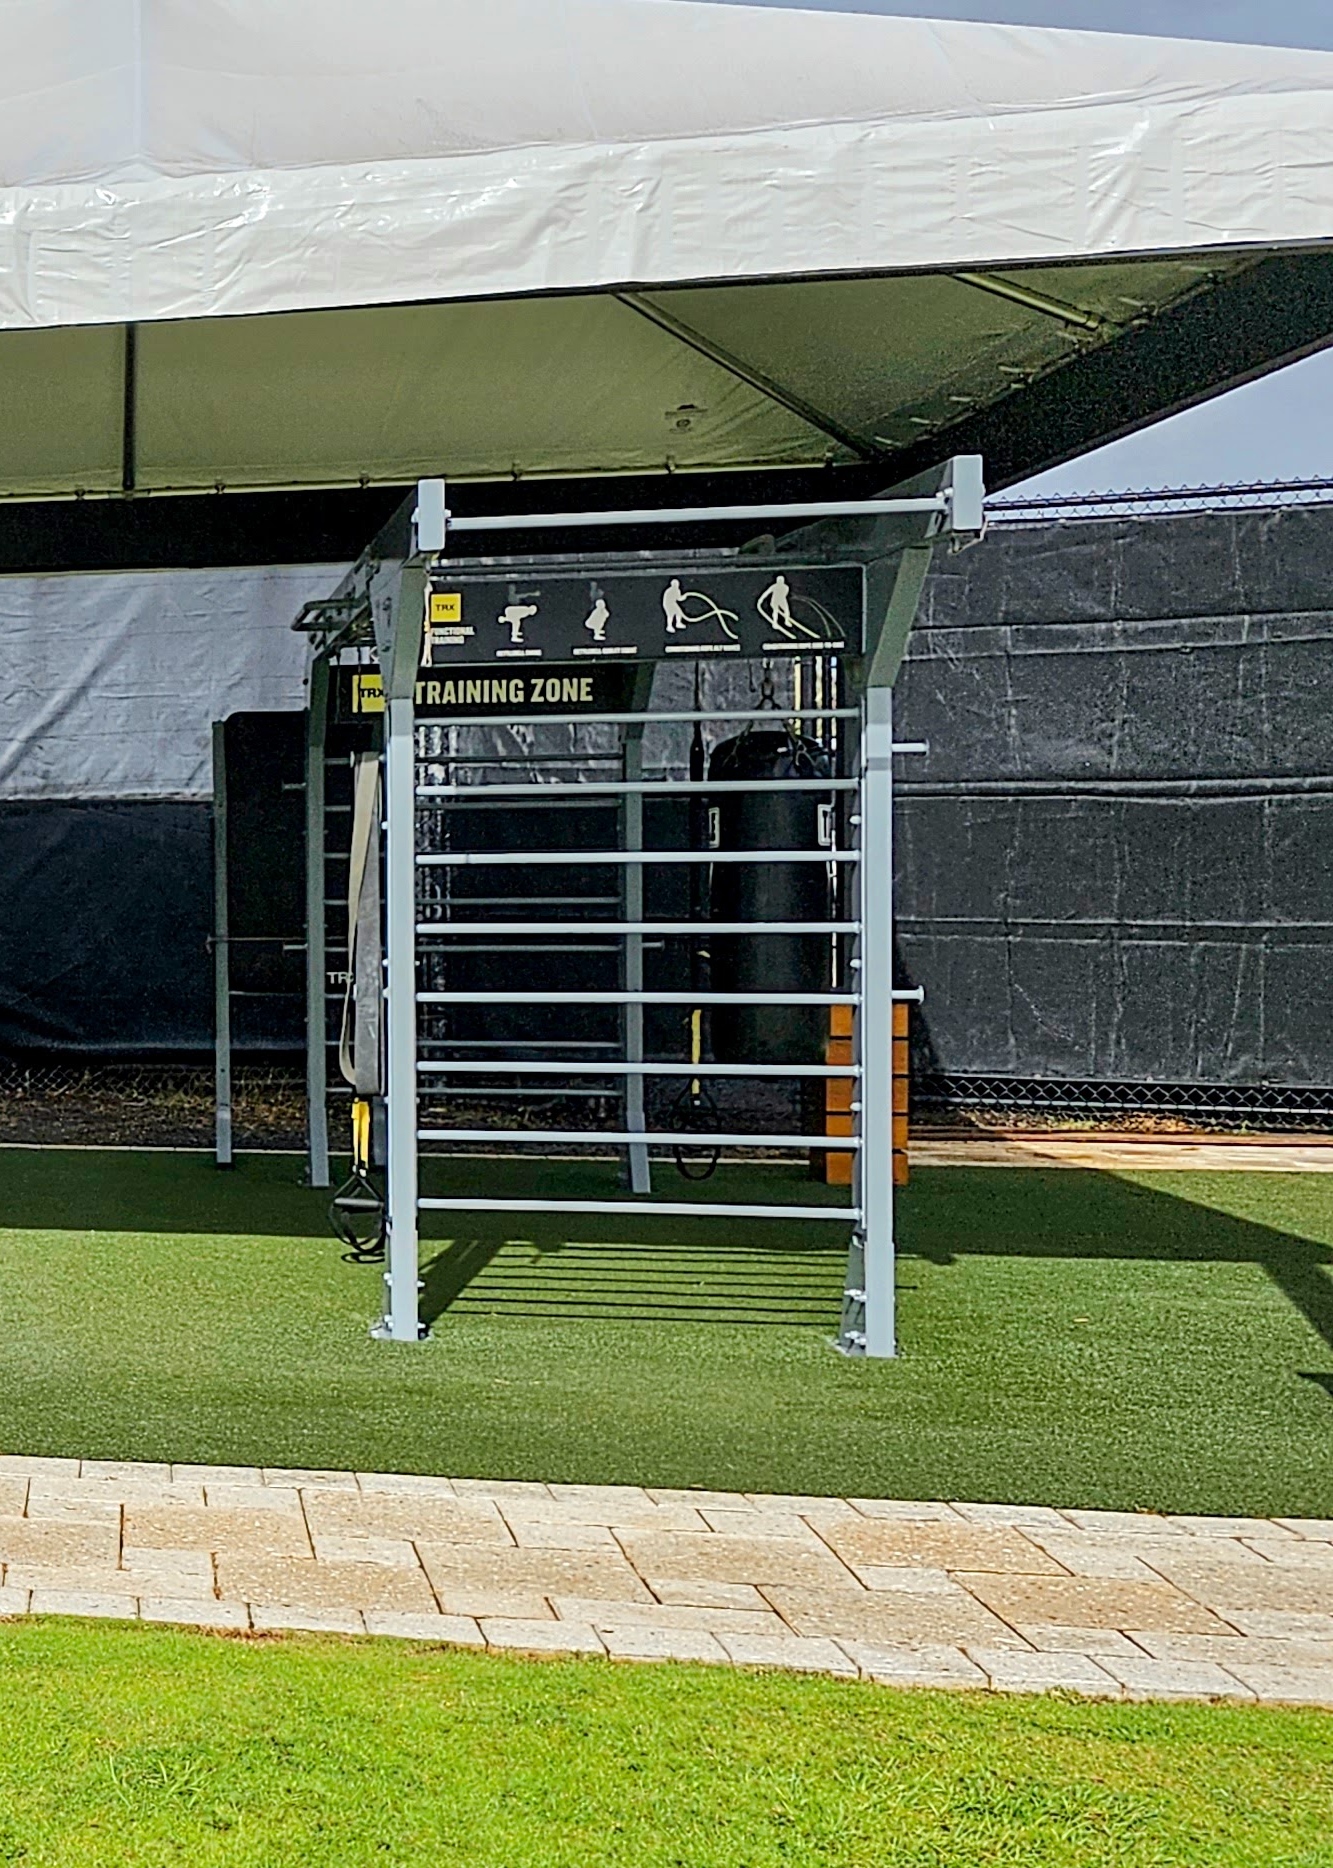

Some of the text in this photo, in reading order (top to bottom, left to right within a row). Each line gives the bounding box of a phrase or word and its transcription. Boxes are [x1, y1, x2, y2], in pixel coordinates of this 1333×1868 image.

[359, 677, 594, 705] TRX TRAINING ZONE
